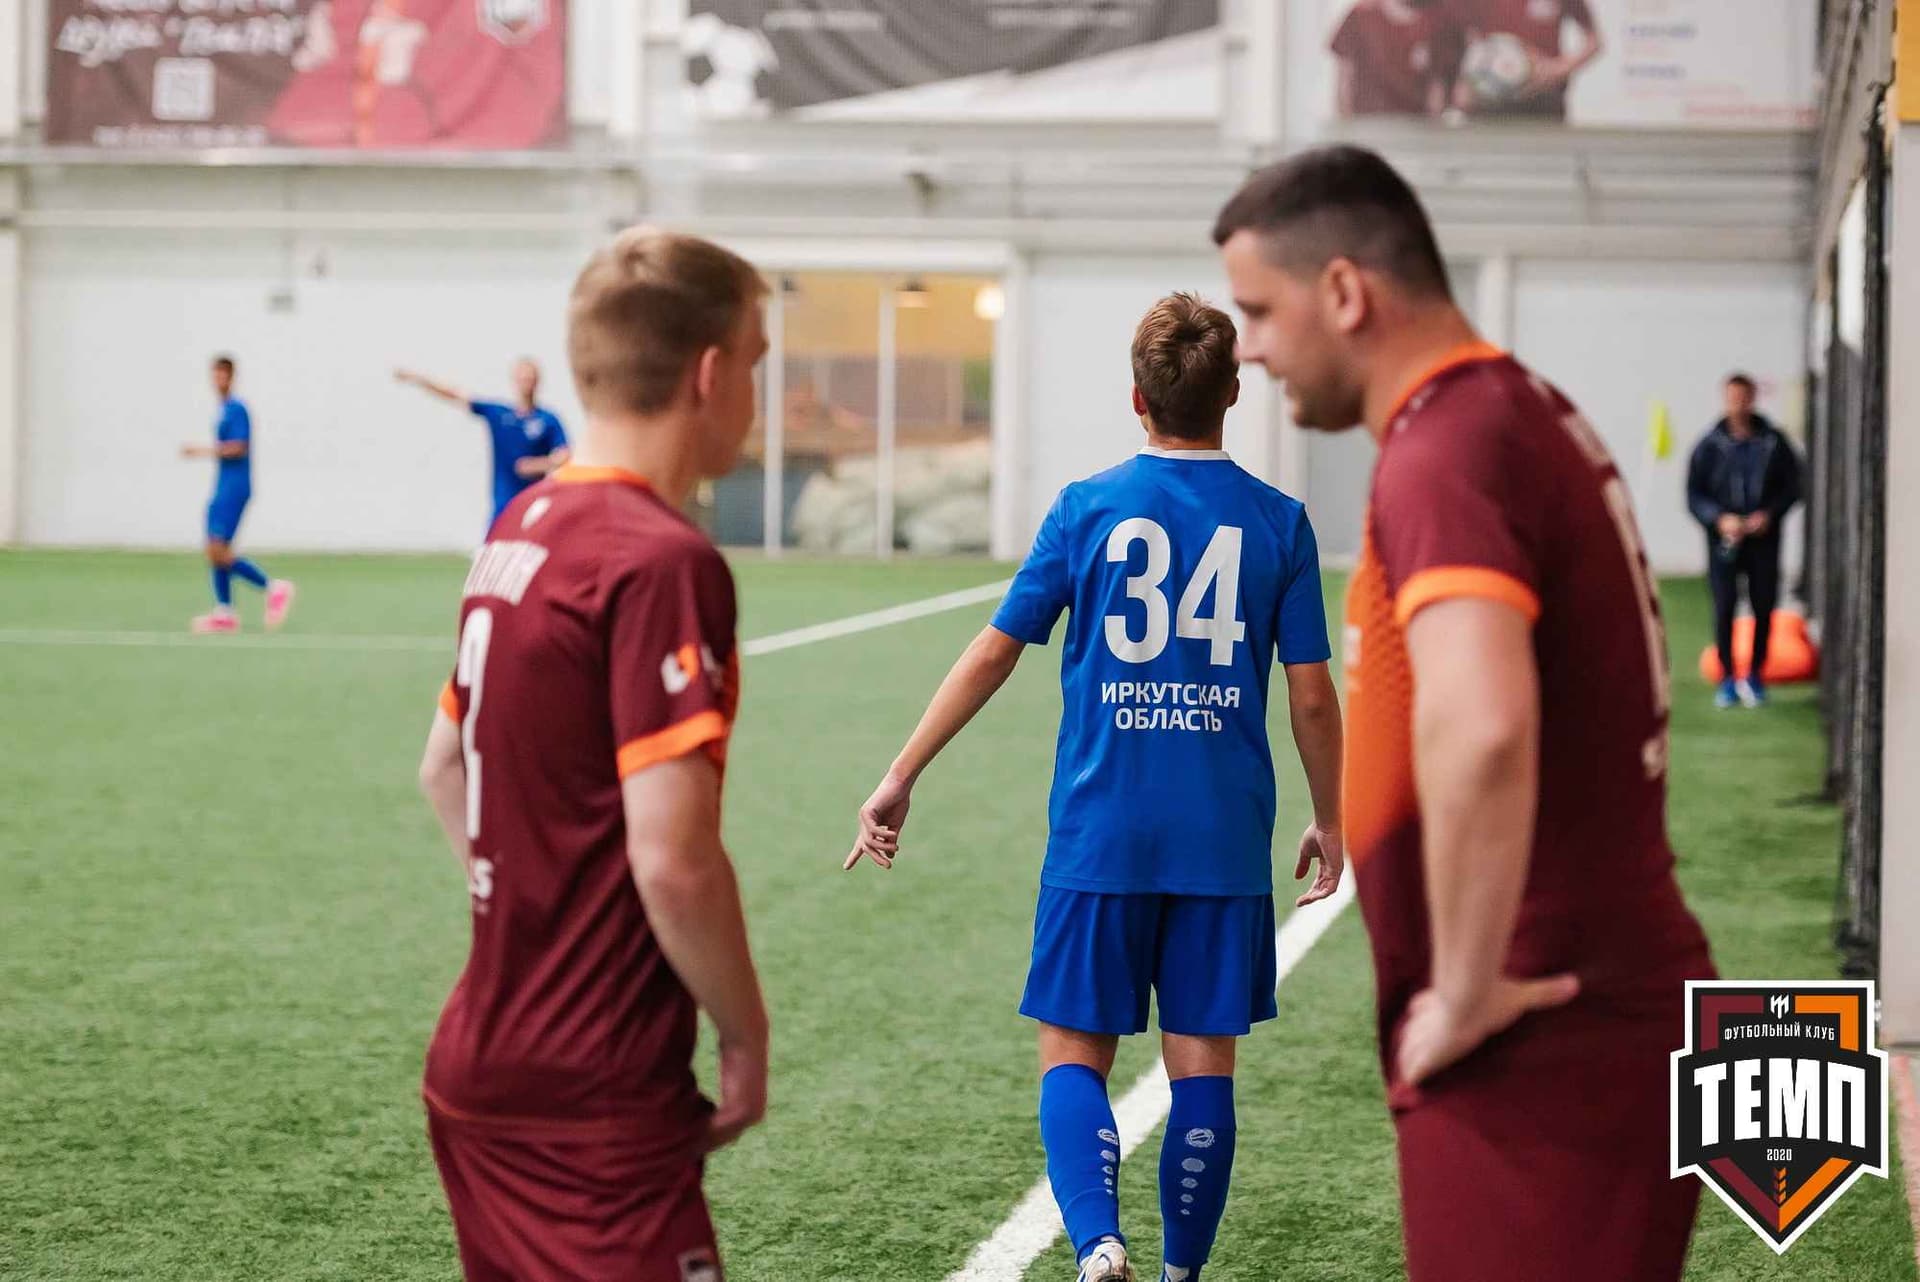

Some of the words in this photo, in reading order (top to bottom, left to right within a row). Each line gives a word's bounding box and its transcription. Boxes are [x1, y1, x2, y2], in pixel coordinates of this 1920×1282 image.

[1105, 517, 1246, 666] 34
[1101, 682, 1240, 709] ИРКУТСКАЯ
[1115, 707, 1223, 732] ОБЛАСТЬ
